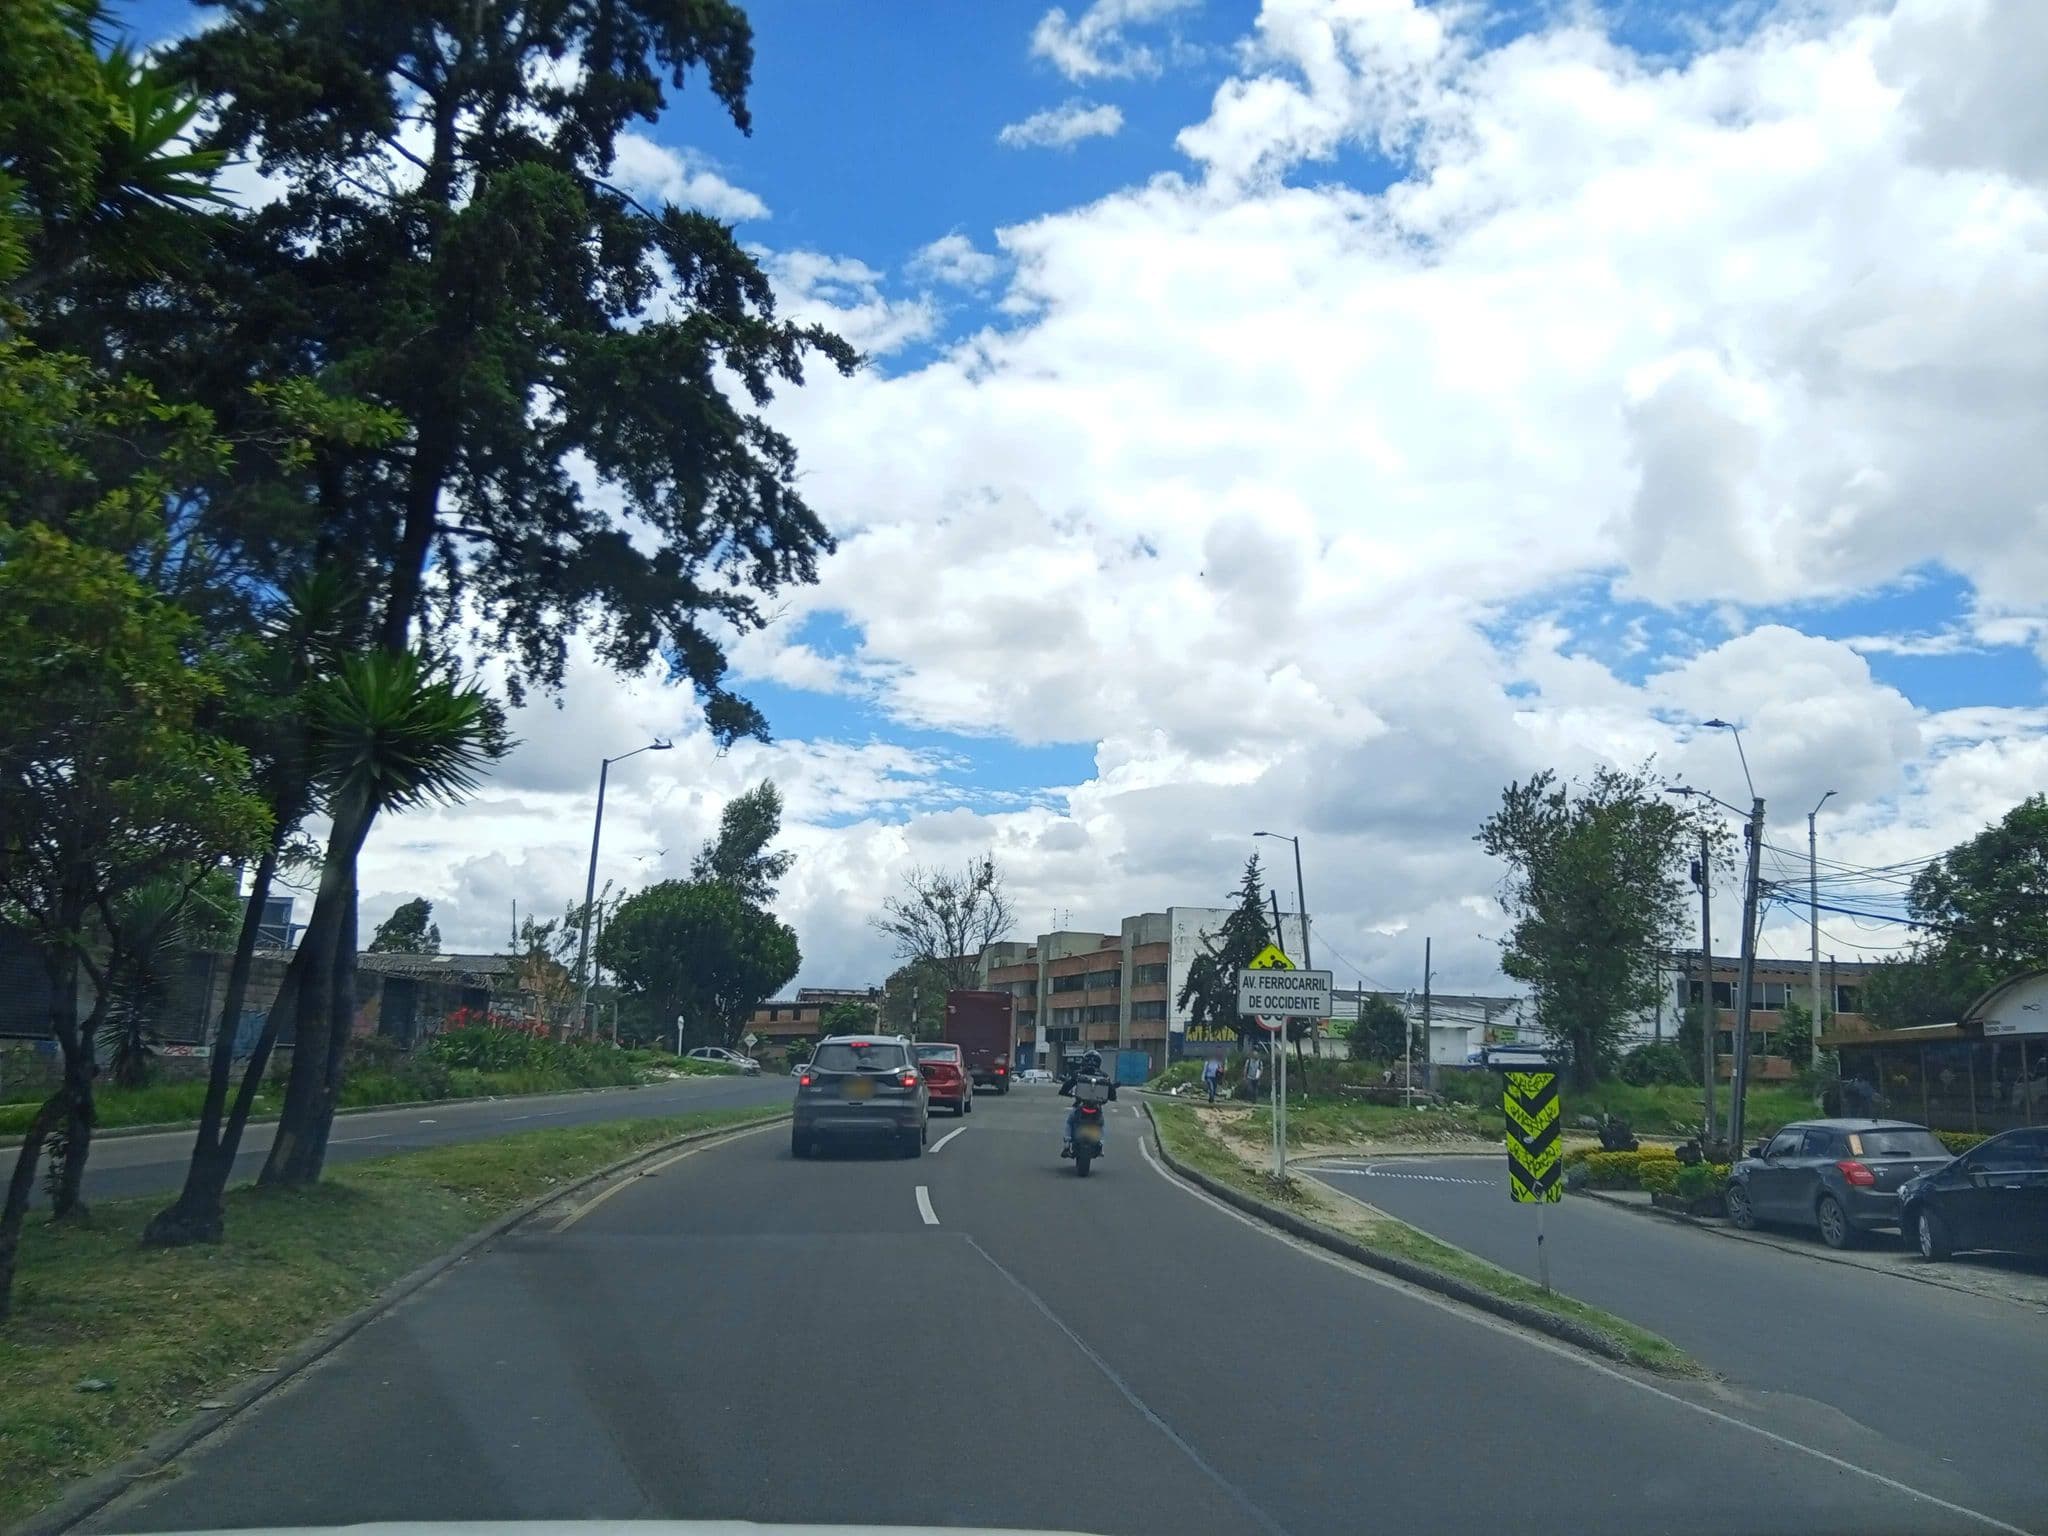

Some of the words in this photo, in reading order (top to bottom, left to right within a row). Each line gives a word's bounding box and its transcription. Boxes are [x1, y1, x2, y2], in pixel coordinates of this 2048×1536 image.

[1242, 975, 1257, 989] AV.
[1258, 976, 1328, 992] FERROCARRIL
[1249, 995, 1262, 1008] DE
[1264, 995, 1320, 1010] OCCIDENTE
